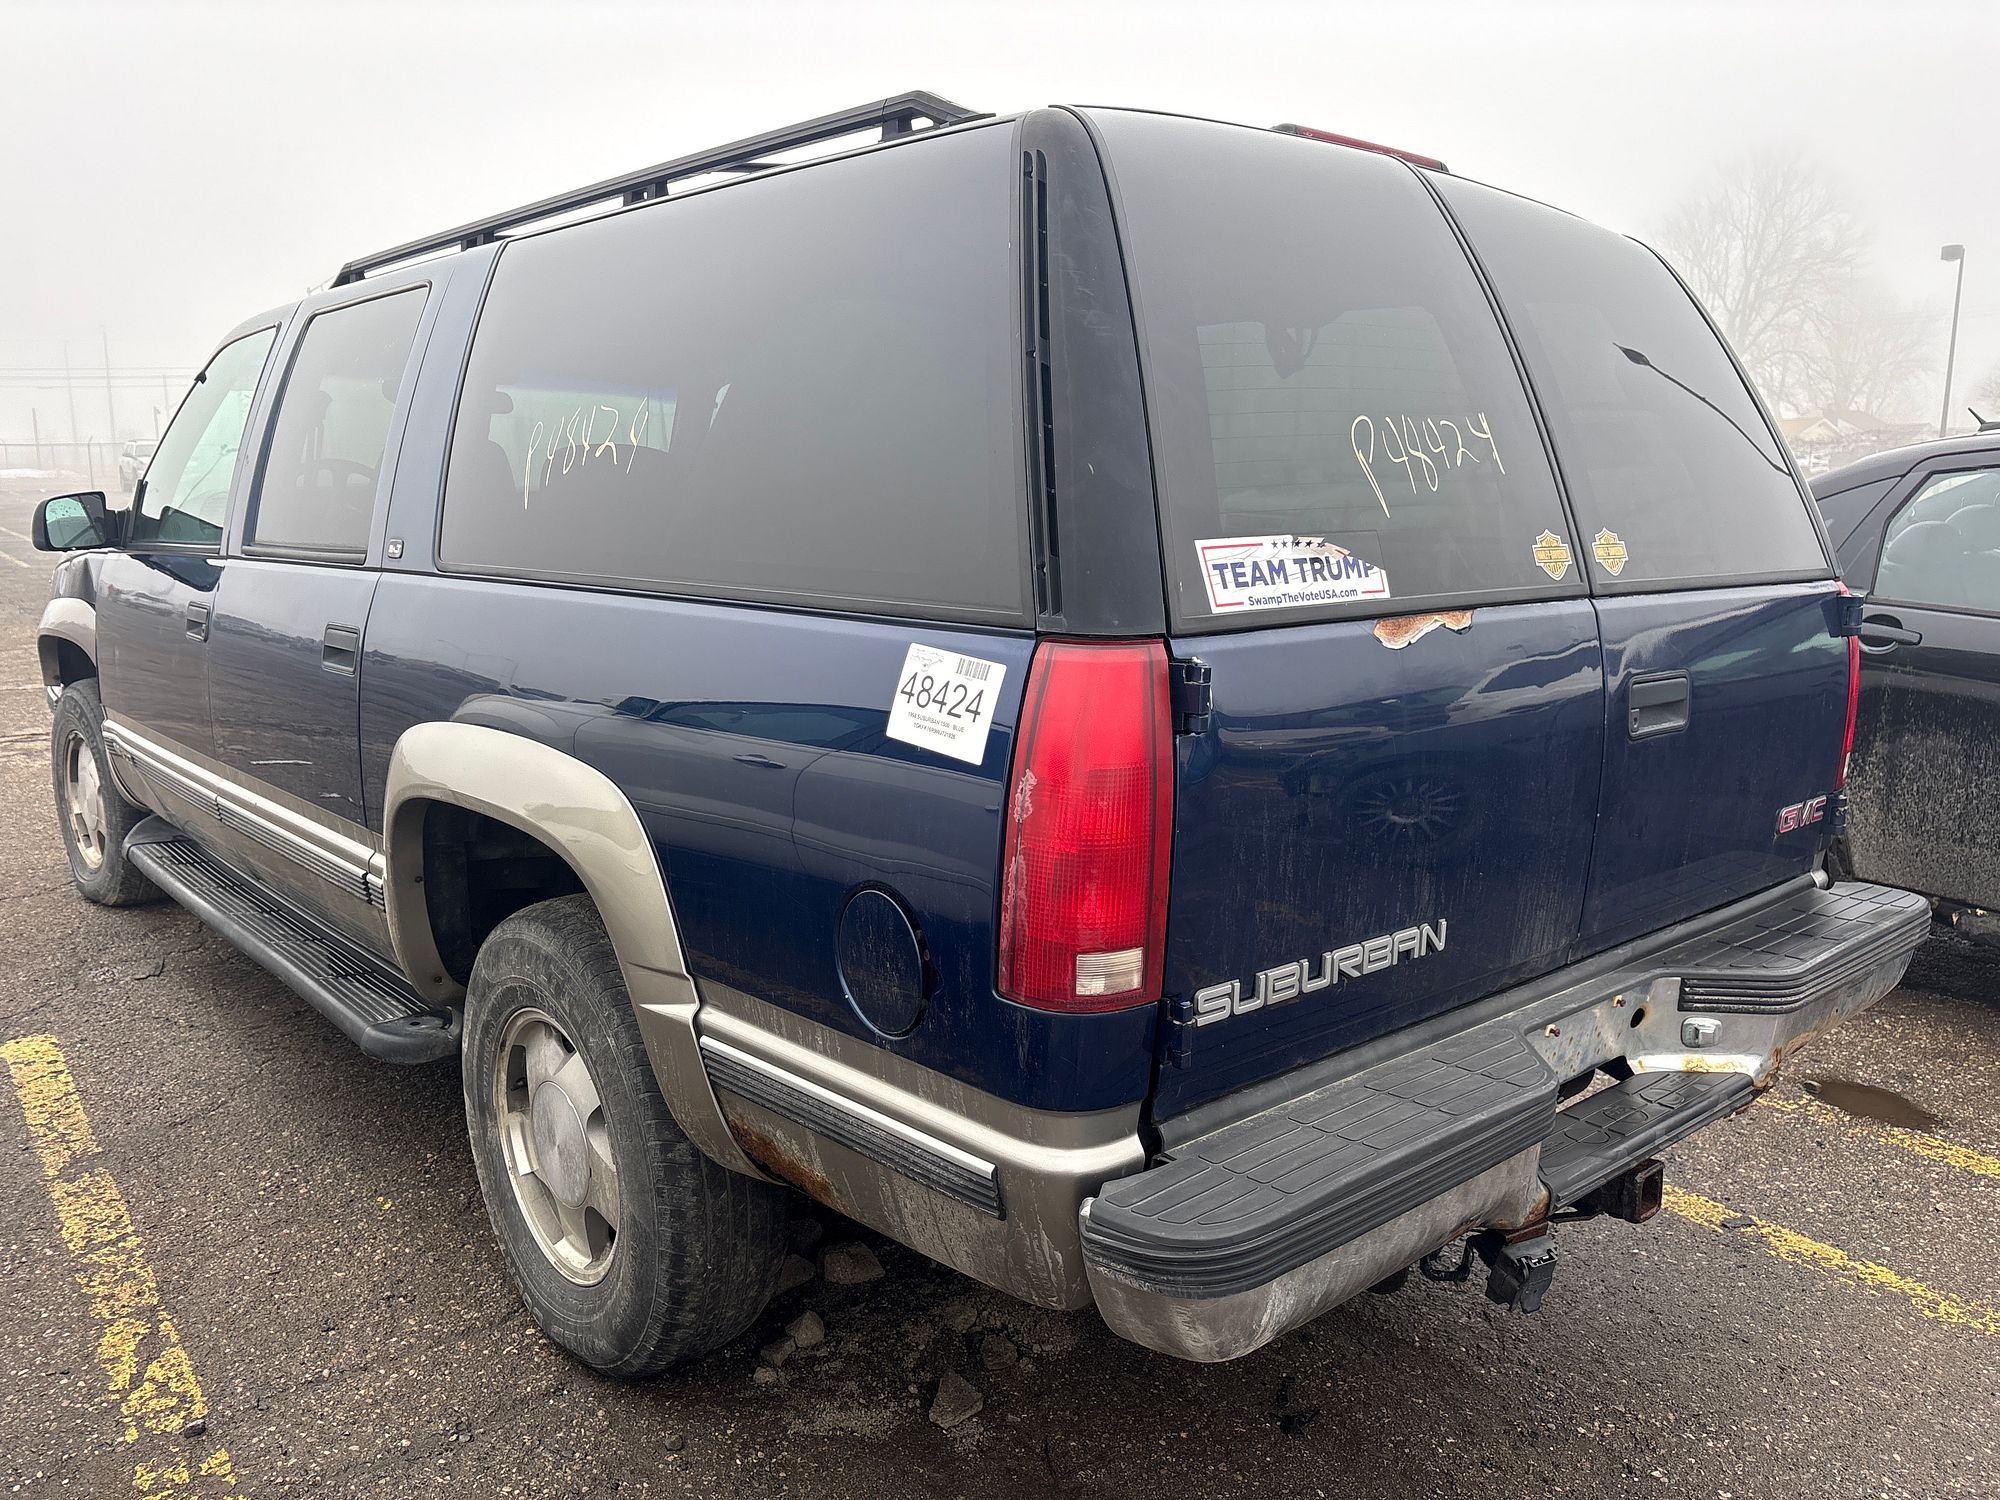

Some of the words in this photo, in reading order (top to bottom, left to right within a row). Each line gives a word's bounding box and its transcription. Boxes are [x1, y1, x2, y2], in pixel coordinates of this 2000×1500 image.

[524, 396, 649, 510] P48424
[1351, 412, 1506, 518] P48424
[1211, 559, 1290, 590] TEAM
[1293, 555, 1375, 583] TRUMP
[1248, 587, 1358, 606] SwampTheVoteUSA.com
[900, 671, 984, 723] 48424
[1778, 794, 1827, 834] GMC
[1193, 918, 1448, 1027] SUBURBAN
